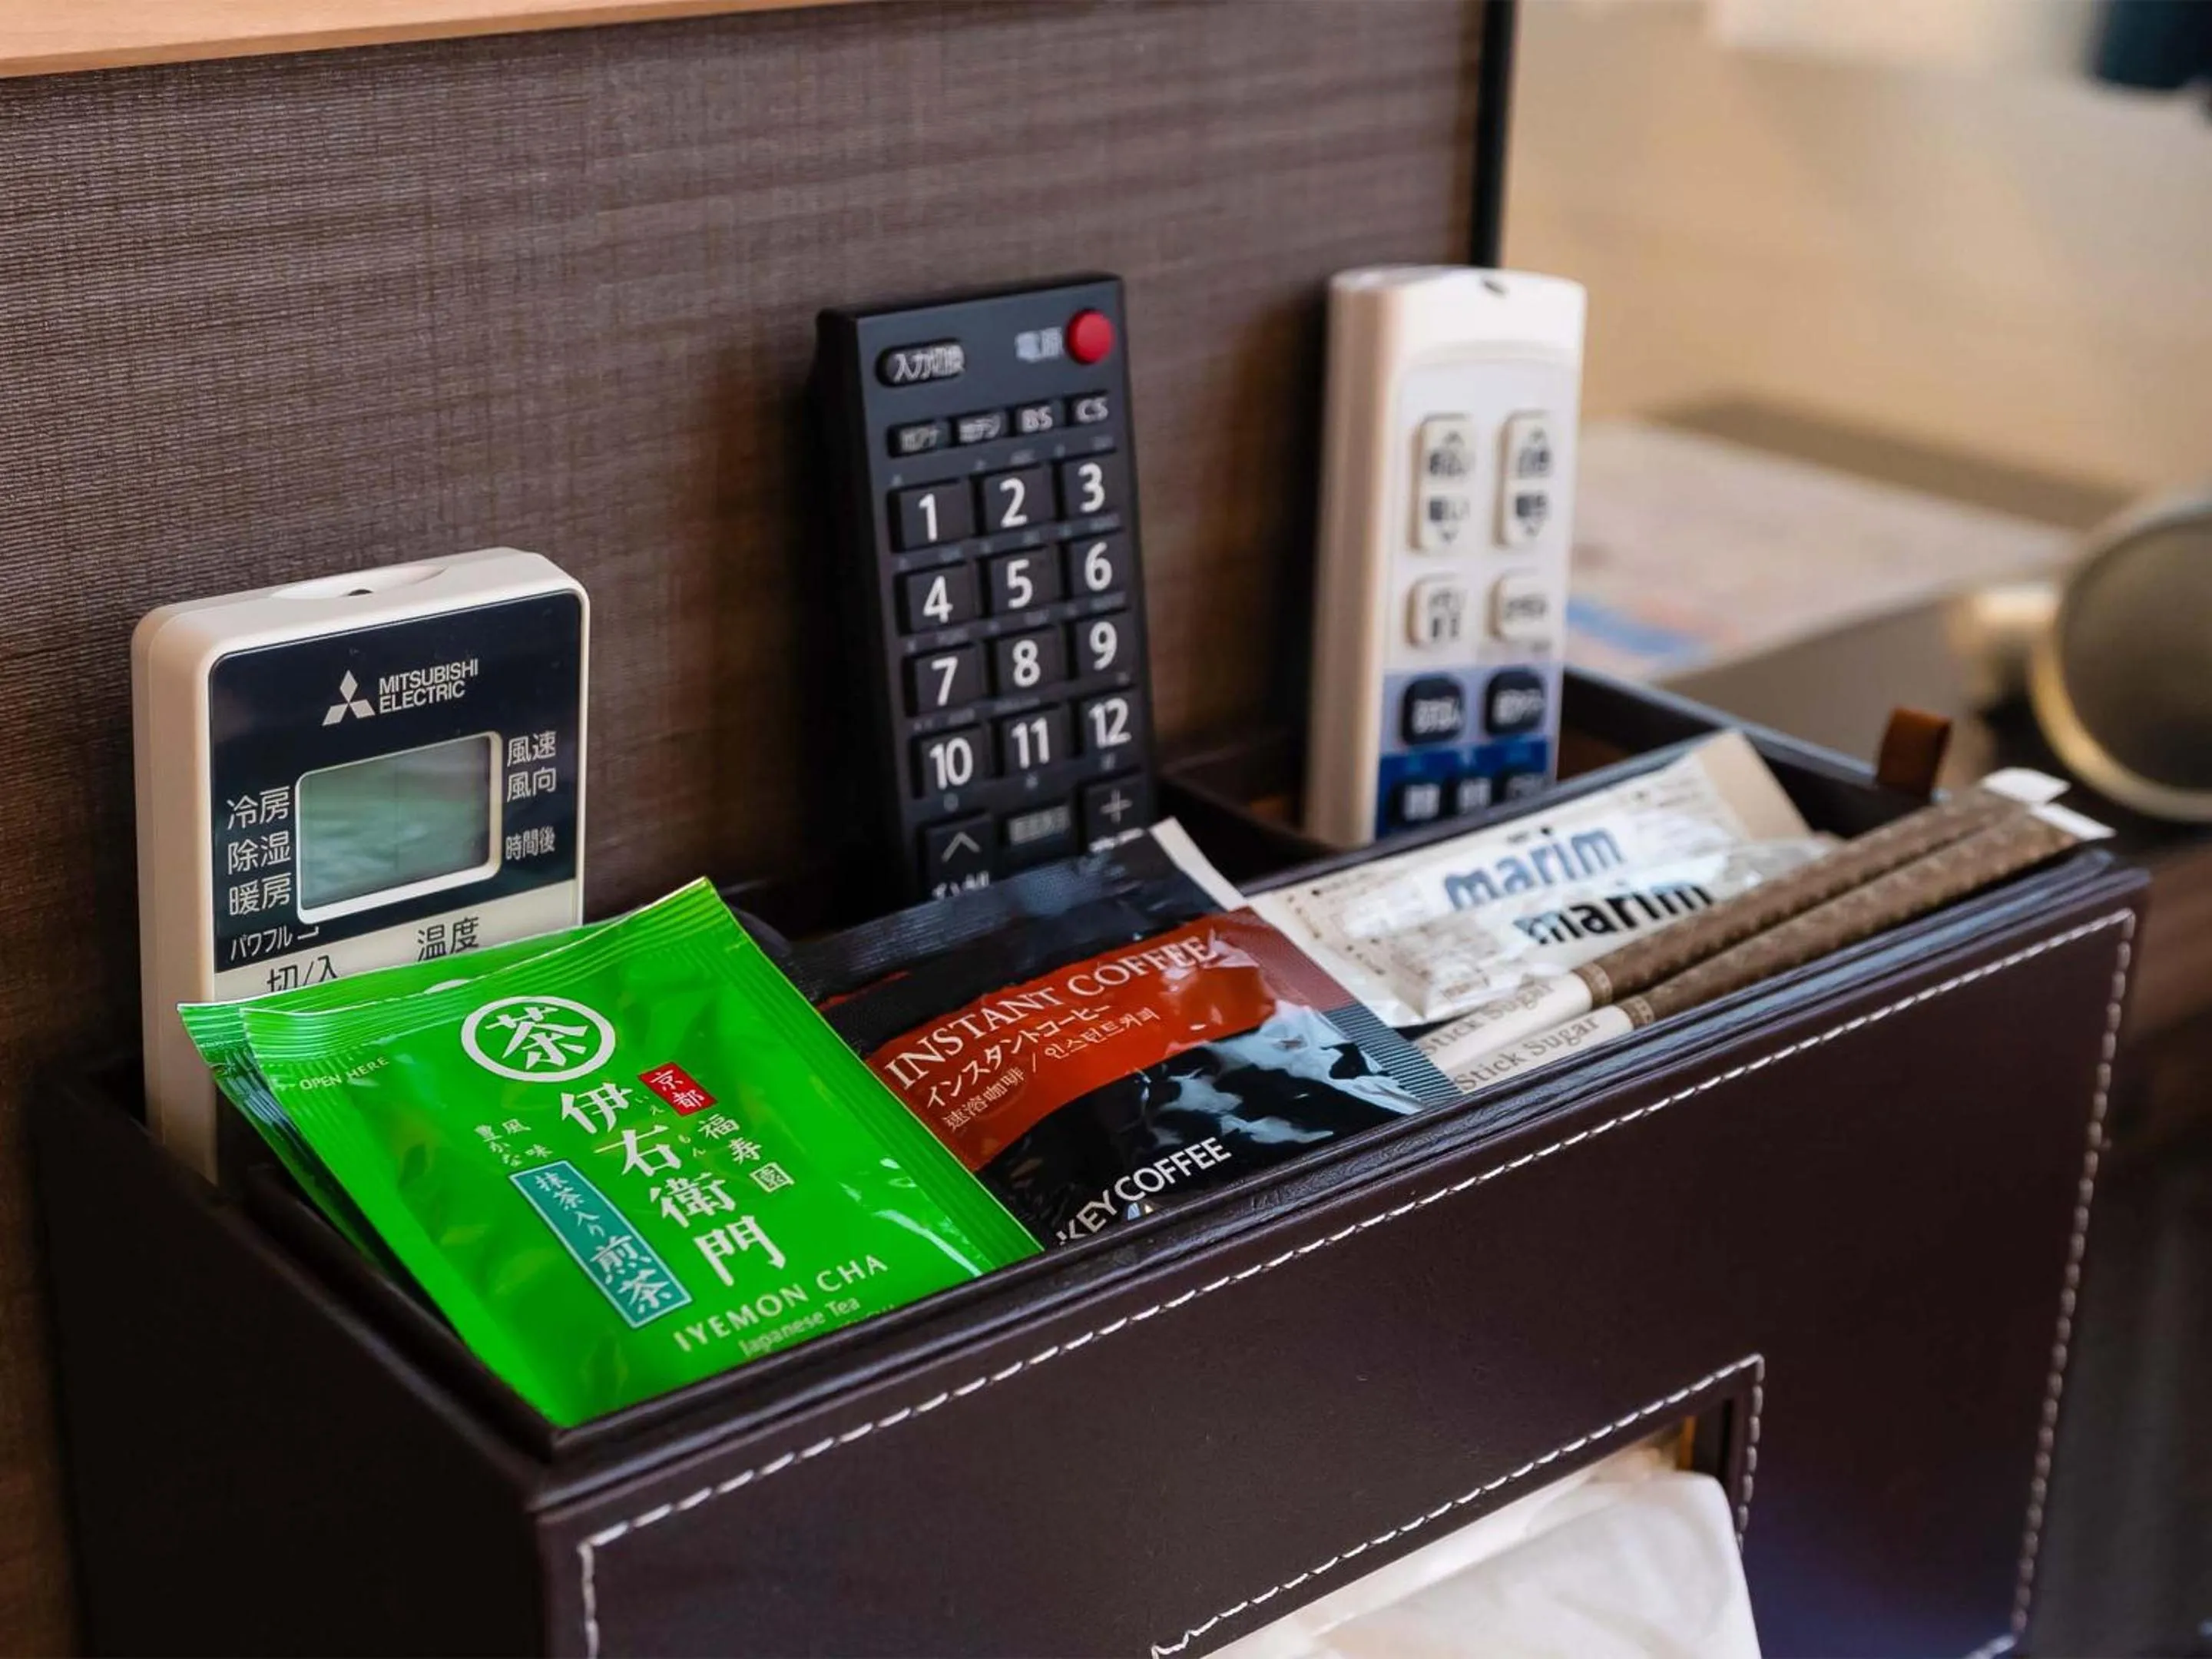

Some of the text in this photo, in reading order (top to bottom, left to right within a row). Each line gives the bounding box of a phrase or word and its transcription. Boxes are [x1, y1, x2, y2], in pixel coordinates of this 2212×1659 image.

[1077, 397, 1108, 422] CS
[1000, 478, 1028, 528] 2
[1078, 462, 1105, 512] 3
[919, 493, 937, 541] 1
[1006, 558, 1033, 608] 5
[1085, 542, 1112, 591] 6
[923, 576, 953, 623] 4
[1013, 640, 1041, 687] 8
[1090, 621, 1117, 670] 9
[379, 659, 478, 694] MITSUBISHI
[379, 680, 465, 714] ELECTRIC
[932, 656, 957, 706] 7
[1012, 717, 1050, 768] 11
[1088, 697, 1131, 749] 12
[507, 730, 557, 767] 風速
[929, 737, 973, 790] 10
[227, 786, 290, 830] 冷房
[507, 767, 557, 802] 風向
[227, 831, 290, 875] 除湿
[505, 826, 555, 861] 時間後
[1444, 824, 1626, 911] marim
[229, 873, 291, 916] 暖房
[1512, 880, 1714, 945] marim
[231, 926, 293, 960] パワフル
[417, 917, 479, 962] 温度
[485, 1006, 588, 1069] 茶
[884, 935, 1217, 1091] INSTANT COFFEE
[1419, 1012, 1485, 1055] Stick
[300, 1056, 389, 1090] OPEN HERE
[927, 1005, 1111, 1108] インスタントコーヒー
[1454, 1015, 1600, 1091] Stick Sugar
[650, 1070, 704, 1108] 京都
[561, 1082, 787, 1287] 伊右衛門
[1114, 1137, 1233, 1201] COFFEE
[673, 1254, 888, 1352] IYEMON CHA
[737, 1310, 826, 1357] Japanese
[824, 1296, 861, 1317] Tea
